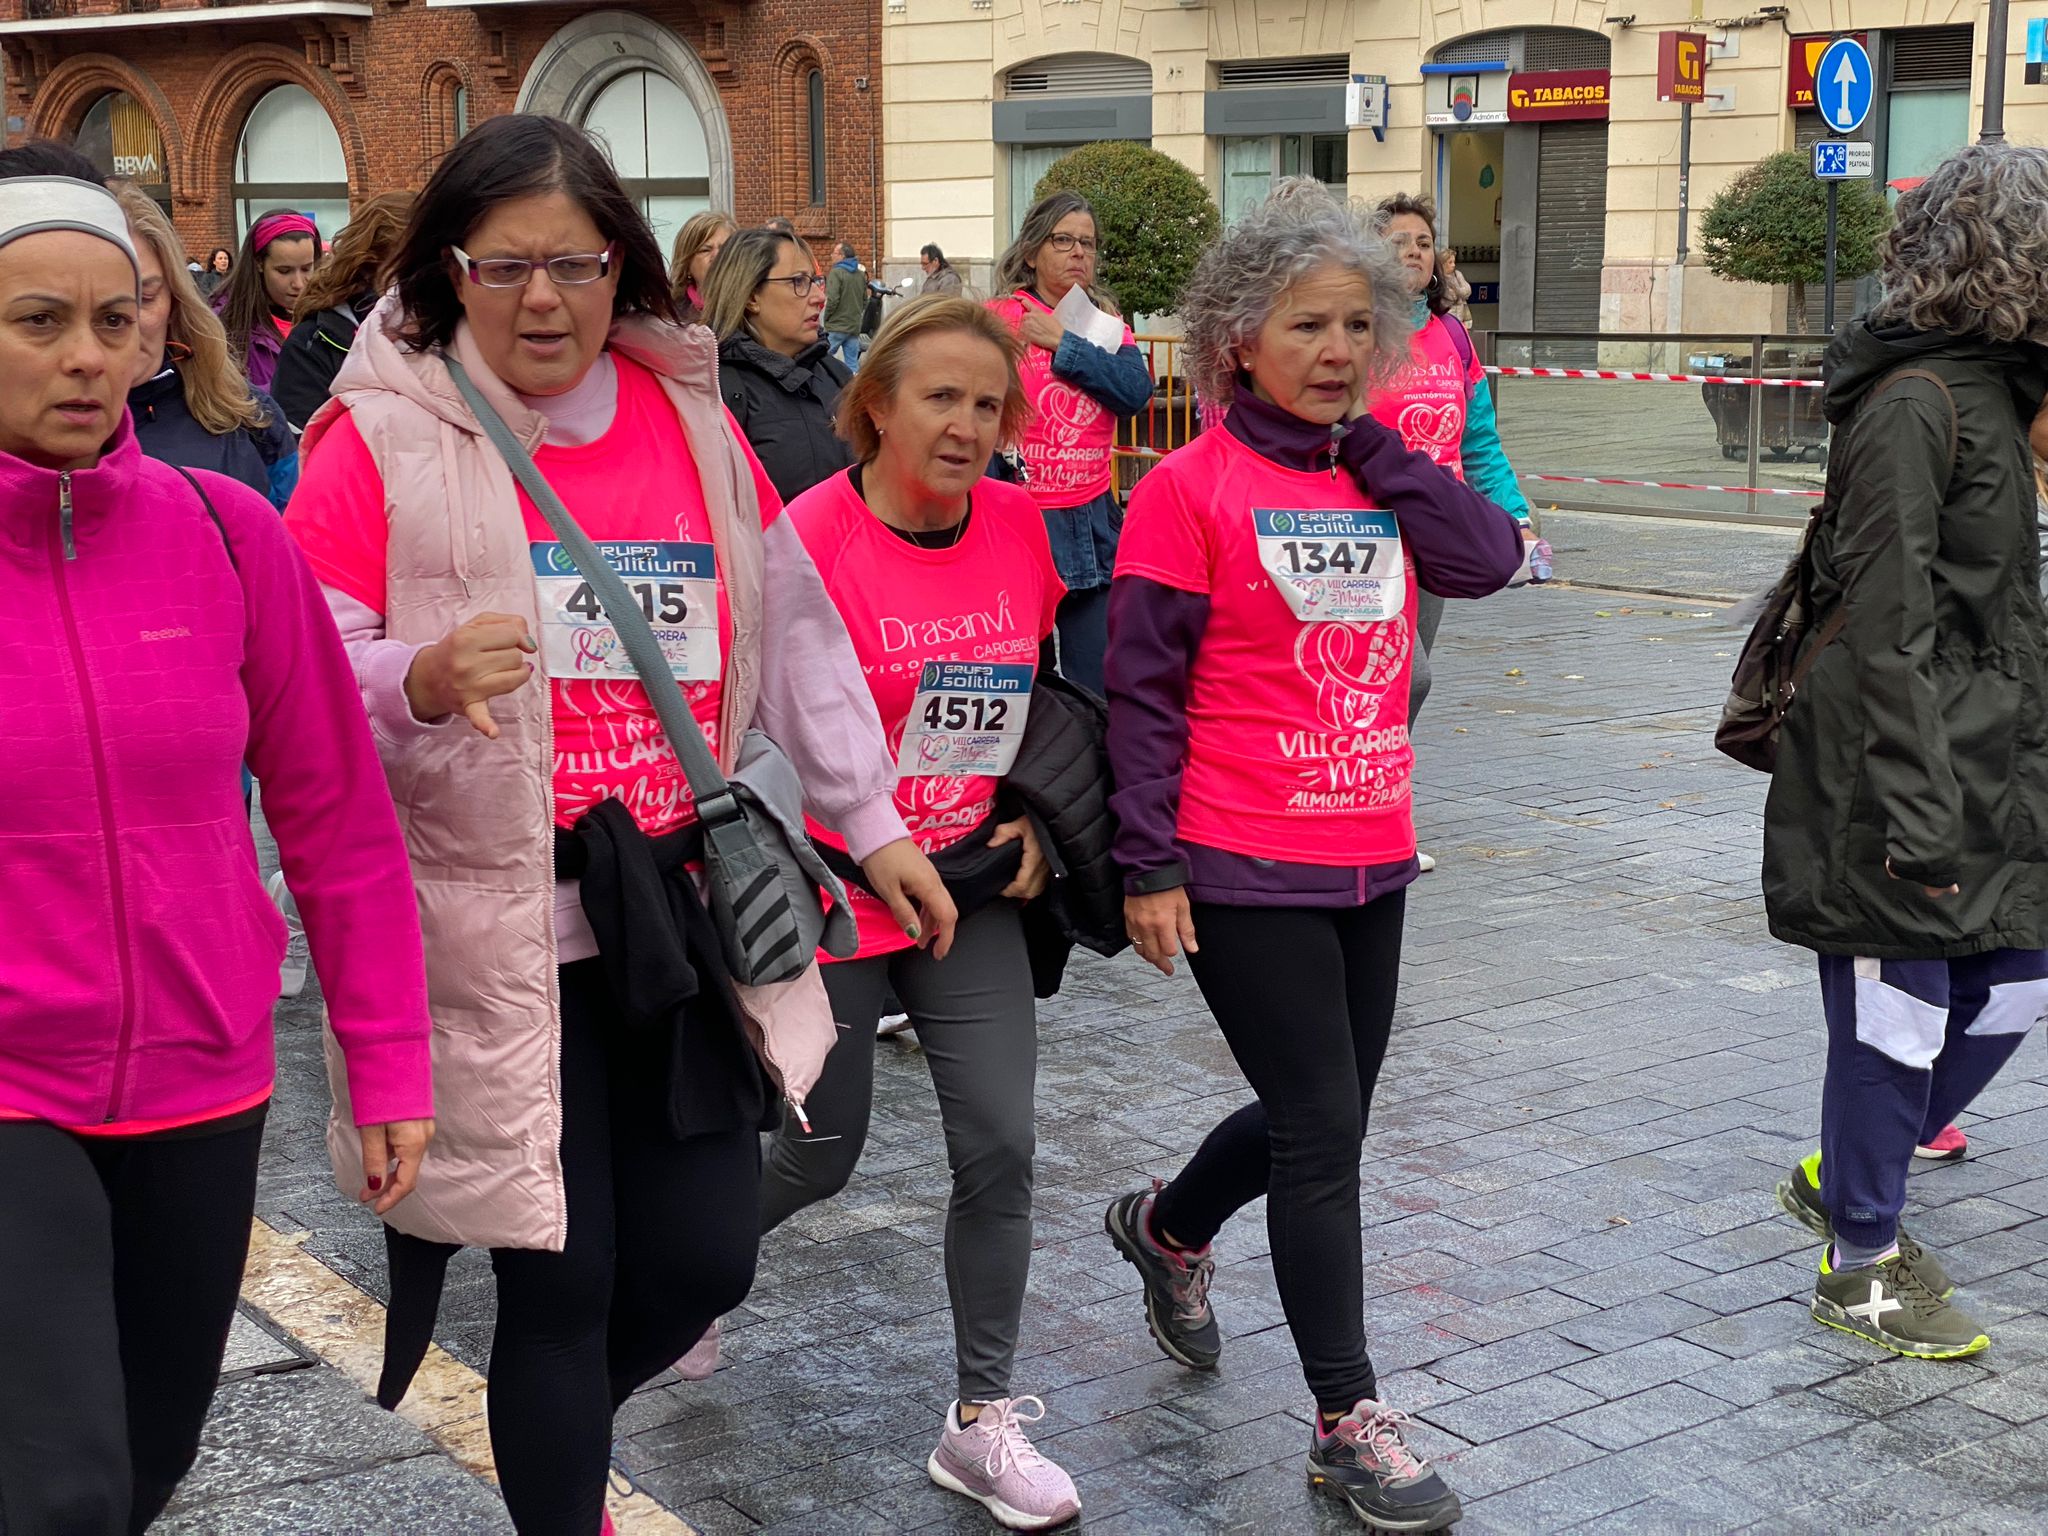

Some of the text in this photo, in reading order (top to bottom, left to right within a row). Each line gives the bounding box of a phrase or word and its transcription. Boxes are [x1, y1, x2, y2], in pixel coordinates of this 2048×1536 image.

[1533, 85, 1605, 102] TABACOS
[1673, 83, 1702, 96] TABACOS
[1426, 115, 1448, 123] Botines
[113, 153, 157, 175] BBVA
[1046, 447, 1104, 461] CARRERA
[1298, 513, 1353, 522] GRUPO
[1300, 523, 1384, 535] solitium
[596, 545, 658, 557] RUPO
[1281, 541, 1378, 575] 1347
[606, 556, 697, 574] olitium
[1341, 579, 1381, 589] CARRERA
[565, 581, 688, 625] 415
[139, 626, 193, 642] Reebok
[973, 637, 1037, 660] CAROBELS
[943, 664, 994, 676] GRUPO
[941, 675, 1019, 690] solitium
[923, 696, 1009, 732] 4512
[966, 735, 1000, 746] CARRERA
[1276, 724, 1410, 758] VIII CARRER
[592, 775, 694, 824] Muje
[1287, 790, 1355, 808] ALMOM
